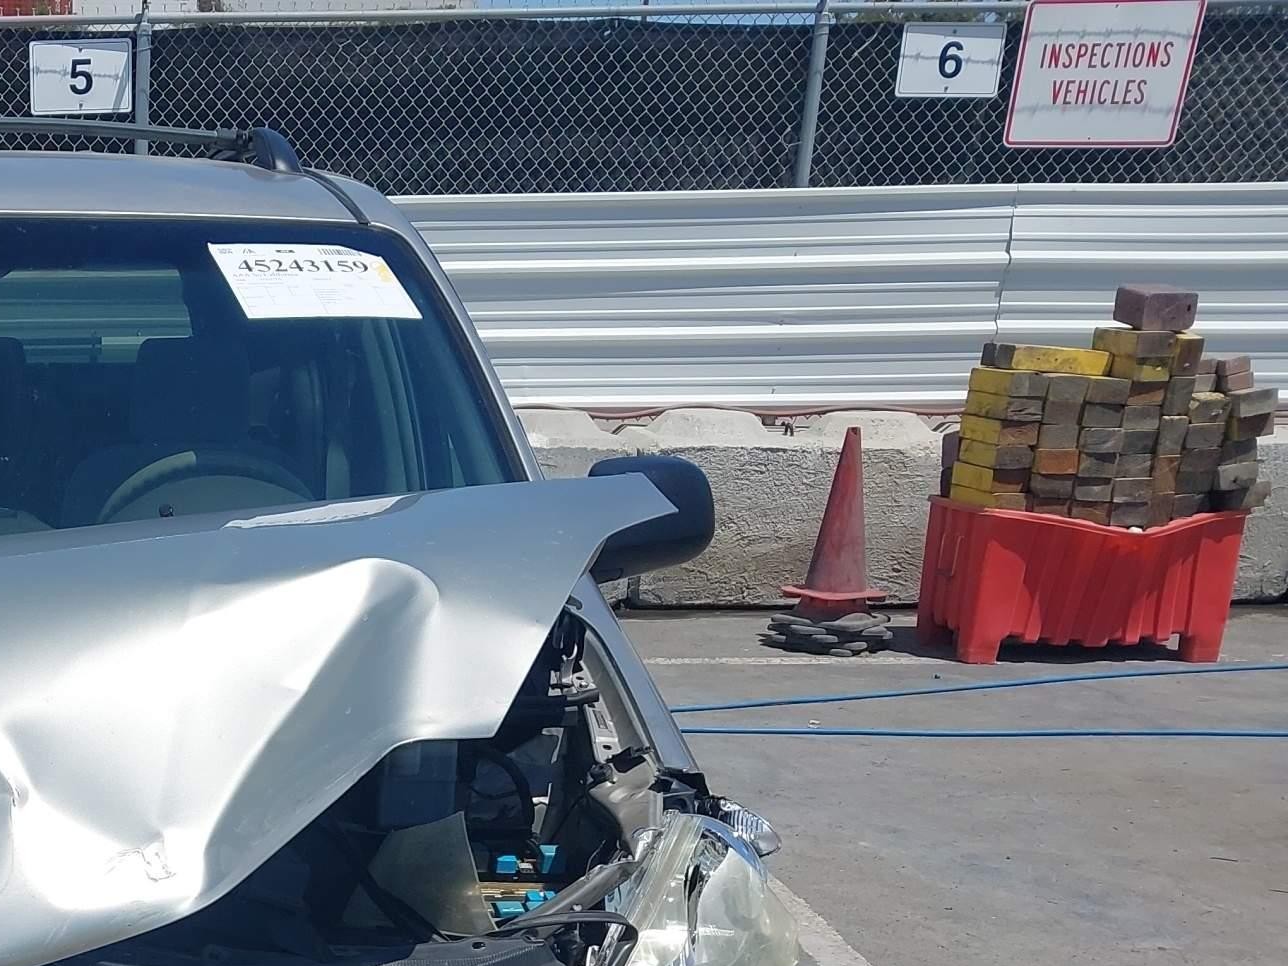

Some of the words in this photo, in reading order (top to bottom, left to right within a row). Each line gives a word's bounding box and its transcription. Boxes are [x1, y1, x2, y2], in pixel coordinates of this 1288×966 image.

[937, 41, 964, 79] 6
[1039, 41, 1175, 69] INSPECTIONS
[69, 58, 94, 95] 5
[1051, 79, 1148, 105] VEHICLES
[237, 259, 369, 273] 45243159
